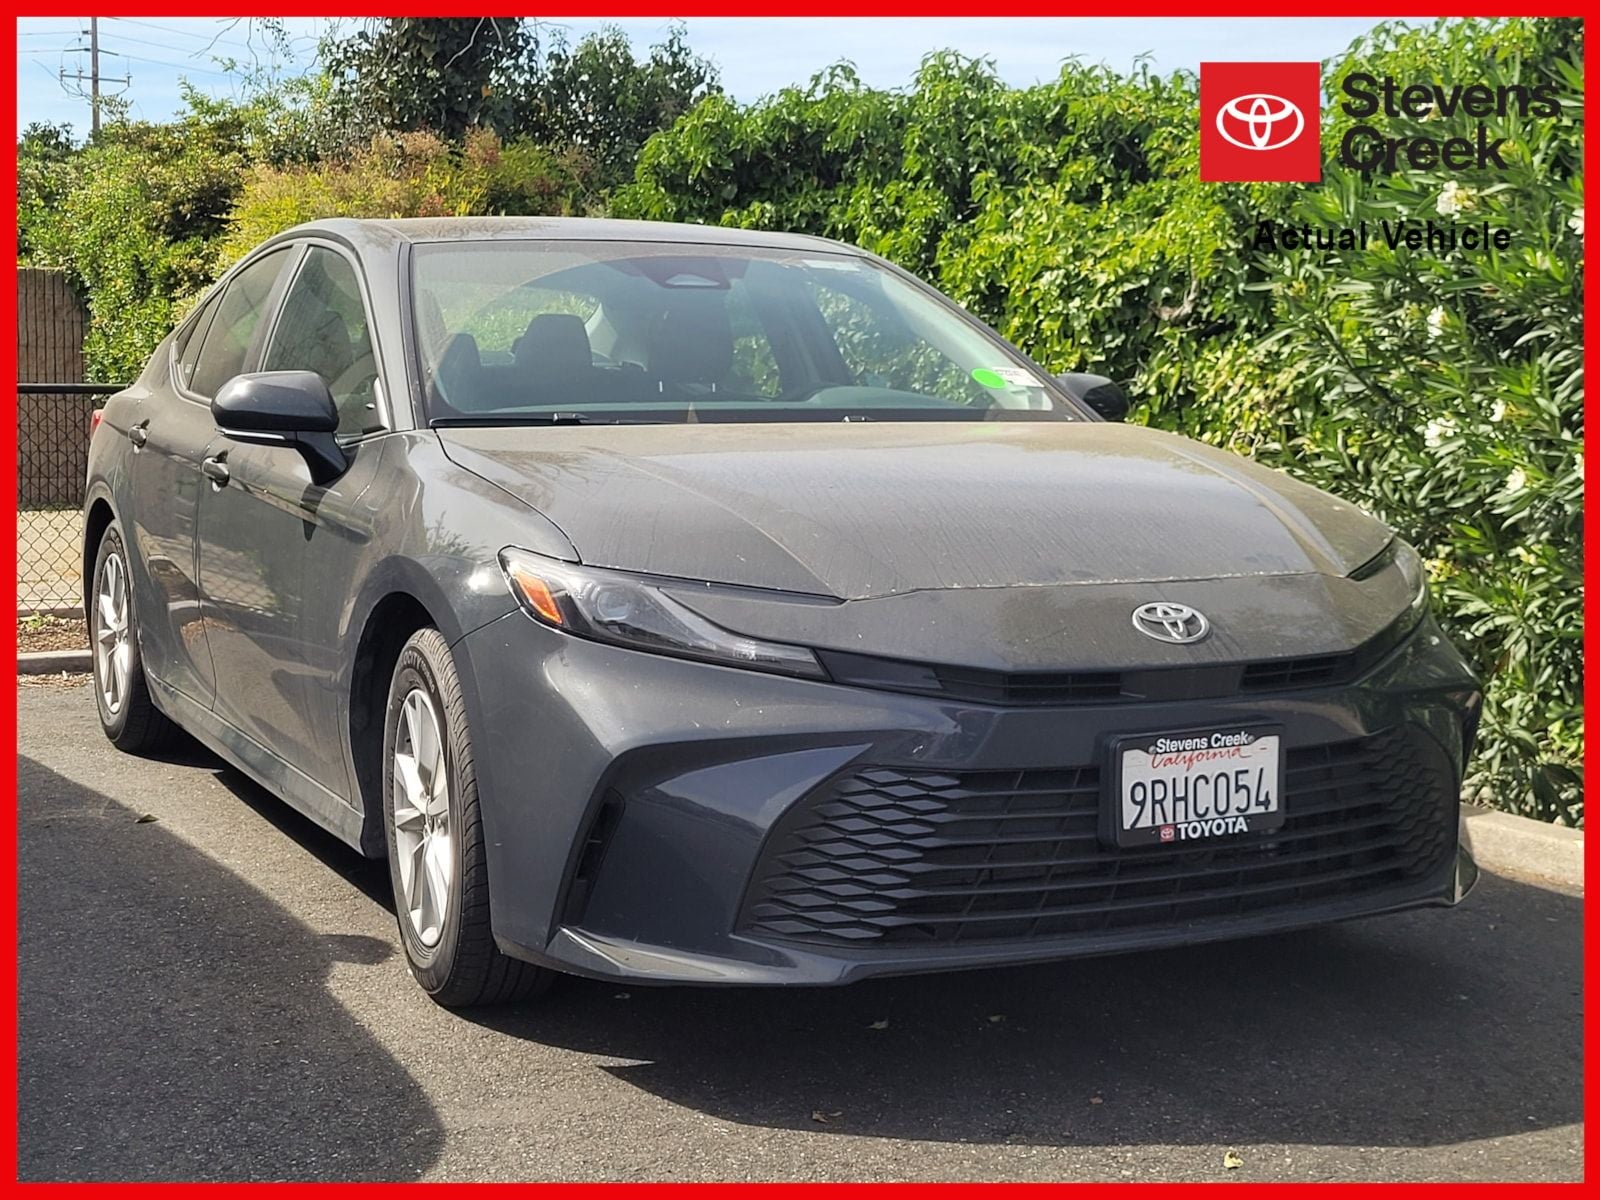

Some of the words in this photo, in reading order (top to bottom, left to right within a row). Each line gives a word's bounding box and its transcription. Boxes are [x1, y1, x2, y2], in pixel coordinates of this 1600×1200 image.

[1155, 735, 1208, 754] Stevens
[1210, 731, 1249, 749] Creek
[1151, 746, 1252, 772] California
[1129, 767, 1272, 830] 9RHC054
[1177, 815, 1249, 841] TOYOTA
